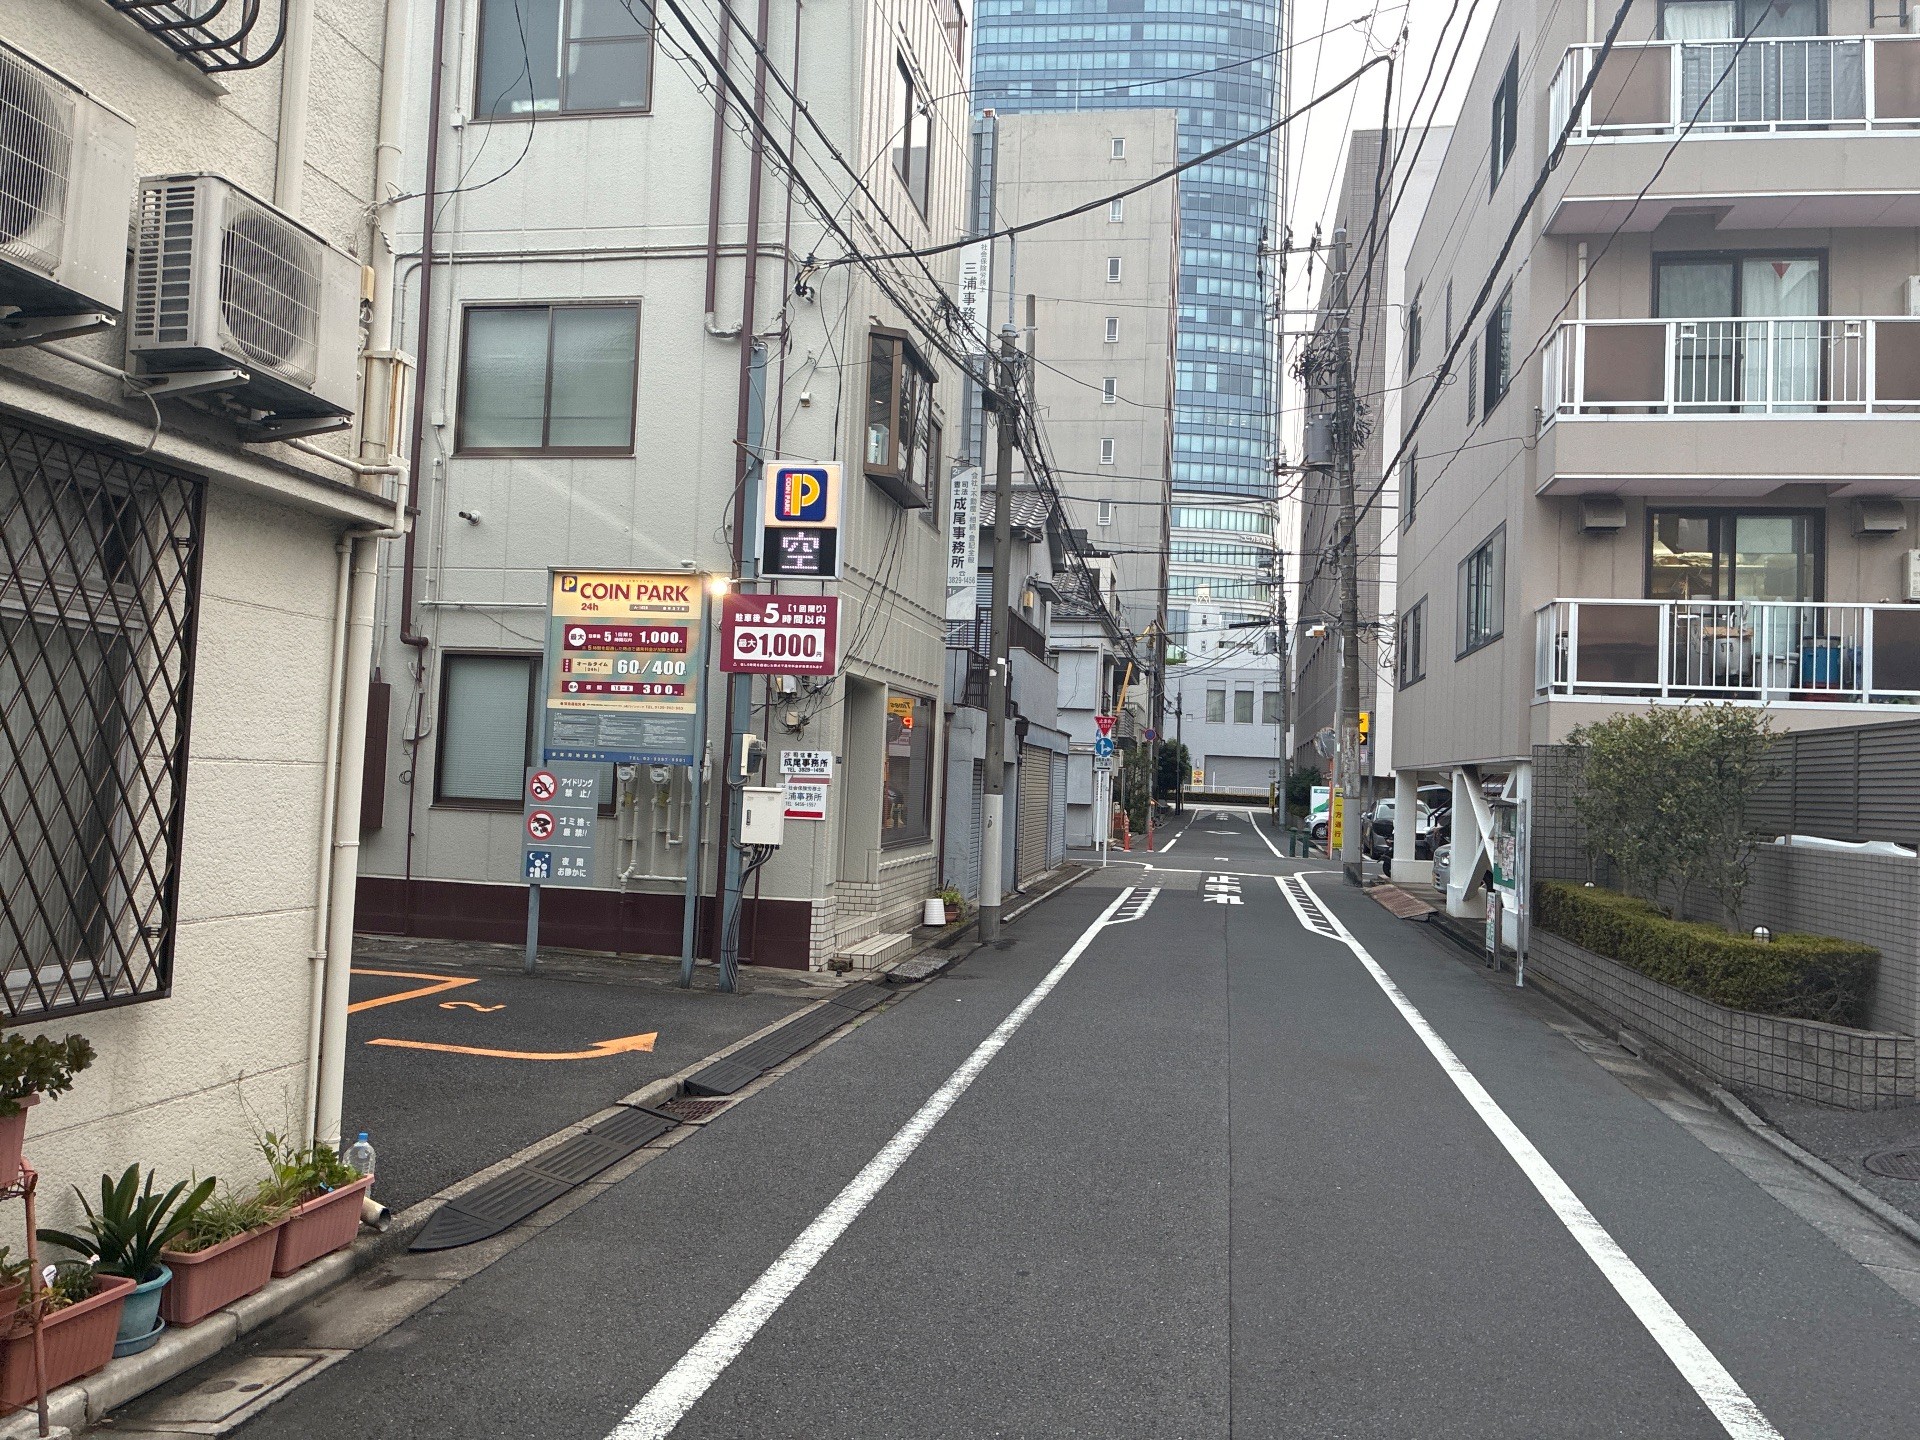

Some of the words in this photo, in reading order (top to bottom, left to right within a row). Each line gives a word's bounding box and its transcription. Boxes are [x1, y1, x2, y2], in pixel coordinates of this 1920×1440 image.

[951, 497, 967, 569] 成尾事務所
[781, 532, 819, 570] 空
[580, 583, 630, 600] COIN
[636, 585, 690, 602] PARK
[581, 602, 599, 611] 24h
[735, 613, 761, 623] 駐車後
[763, 603, 780, 624] 5
[781, 614, 826, 625] 時間以内
[603, 631, 612, 643] 5
[738, 639, 756, 648] 最大
[784, 758, 828, 767] 成尾事務所
[561, 778, 593, 787] アイドリング
[785, 792, 822, 801] 浦事務所
[559, 817, 591, 827] ゴミ捨て
[561, 857, 584, 866] 夜間
[557, 868, 587, 877] お静かに
[1203, 875, 1244, 905] 止まれ
